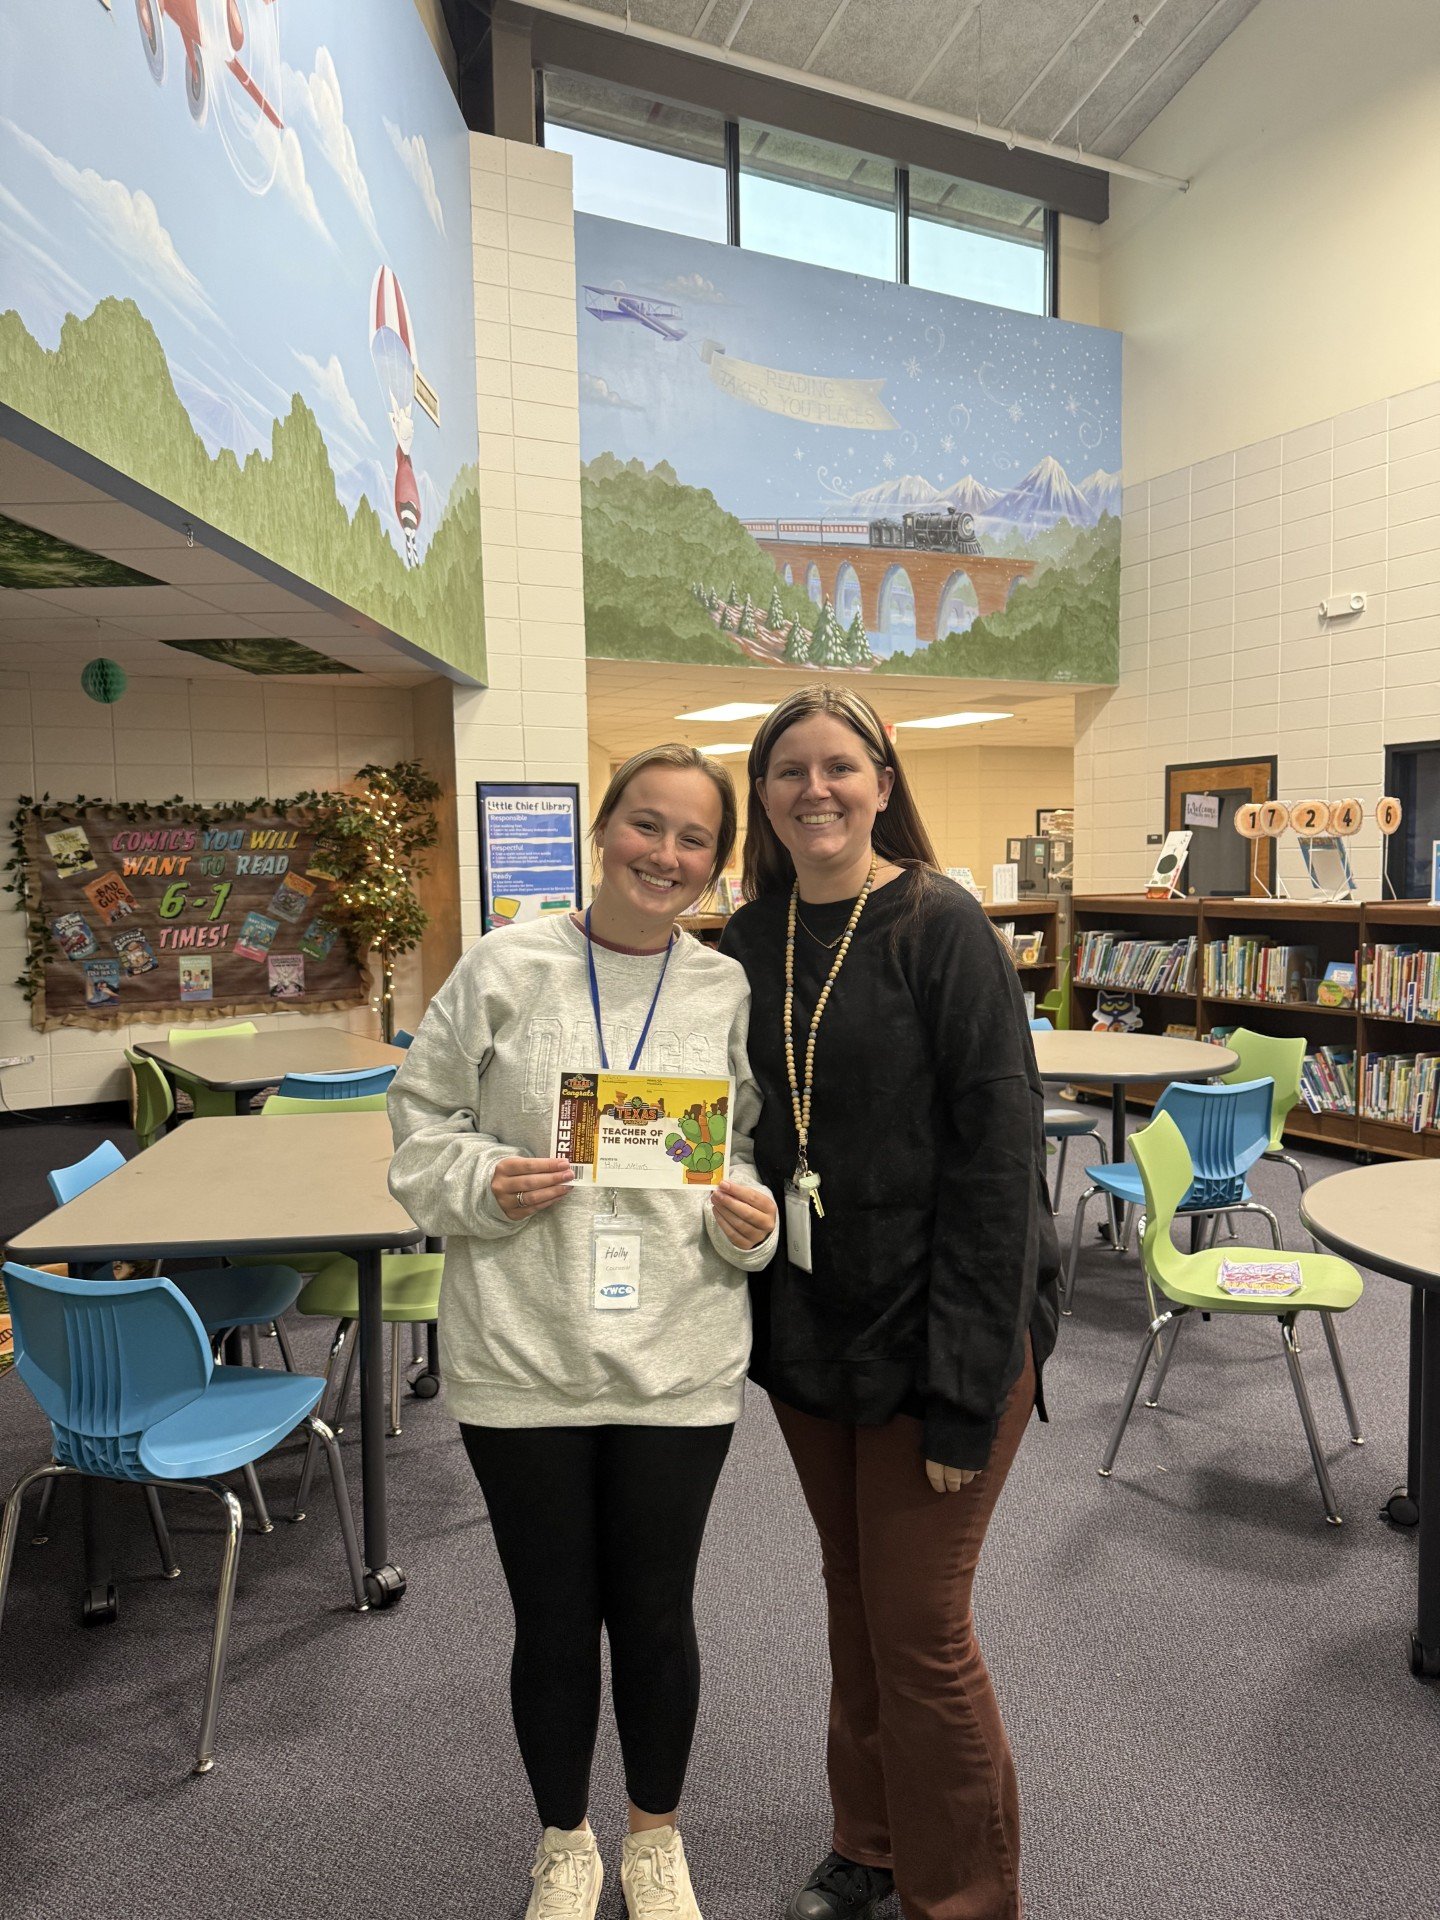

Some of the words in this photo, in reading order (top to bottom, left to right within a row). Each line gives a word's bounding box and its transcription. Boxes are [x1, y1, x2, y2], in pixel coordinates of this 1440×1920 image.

[766, 369, 834, 398] READING
[720, 369, 769, 407] TAKES
[779, 394, 811, 417] YOU
[818, 403, 875, 425] PLACES
[487, 801, 513, 811] Little
[515, 801, 539, 811] Chief
[541, 801, 571, 813] Library
[1385, 806, 1392, 824] 6
[490, 814, 528, 822] Responsible
[1249, 811, 1257, 829] 1
[1267, 809, 1276, 827] 7
[1305, 809, 1316, 828] 2
[1342, 808, 1352, 827] 4
[202, 829, 246, 851] YOU
[250, 830, 300, 850] WILL
[122, 855, 192, 877] WANT
[200, 855, 227, 877] TO
[236, 855, 290, 876] READ
[95, 881, 119, 897] BAD
[98, 888, 126, 908] GUYS
[159, 923, 231, 949] TIMES!
[562, 1088, 595, 1098] Congrats
[616, 1108, 657, 1120] TEXAS
[602, 1127, 647, 1137] TEACHER
[650, 1129, 664, 1137] OF
[602, 1136, 621, 1144] THE
[624, 1137, 659, 1146] MONTH
[605, 1246, 629, 1261] Holly
[603, 1286, 633, 1295] YWCO
